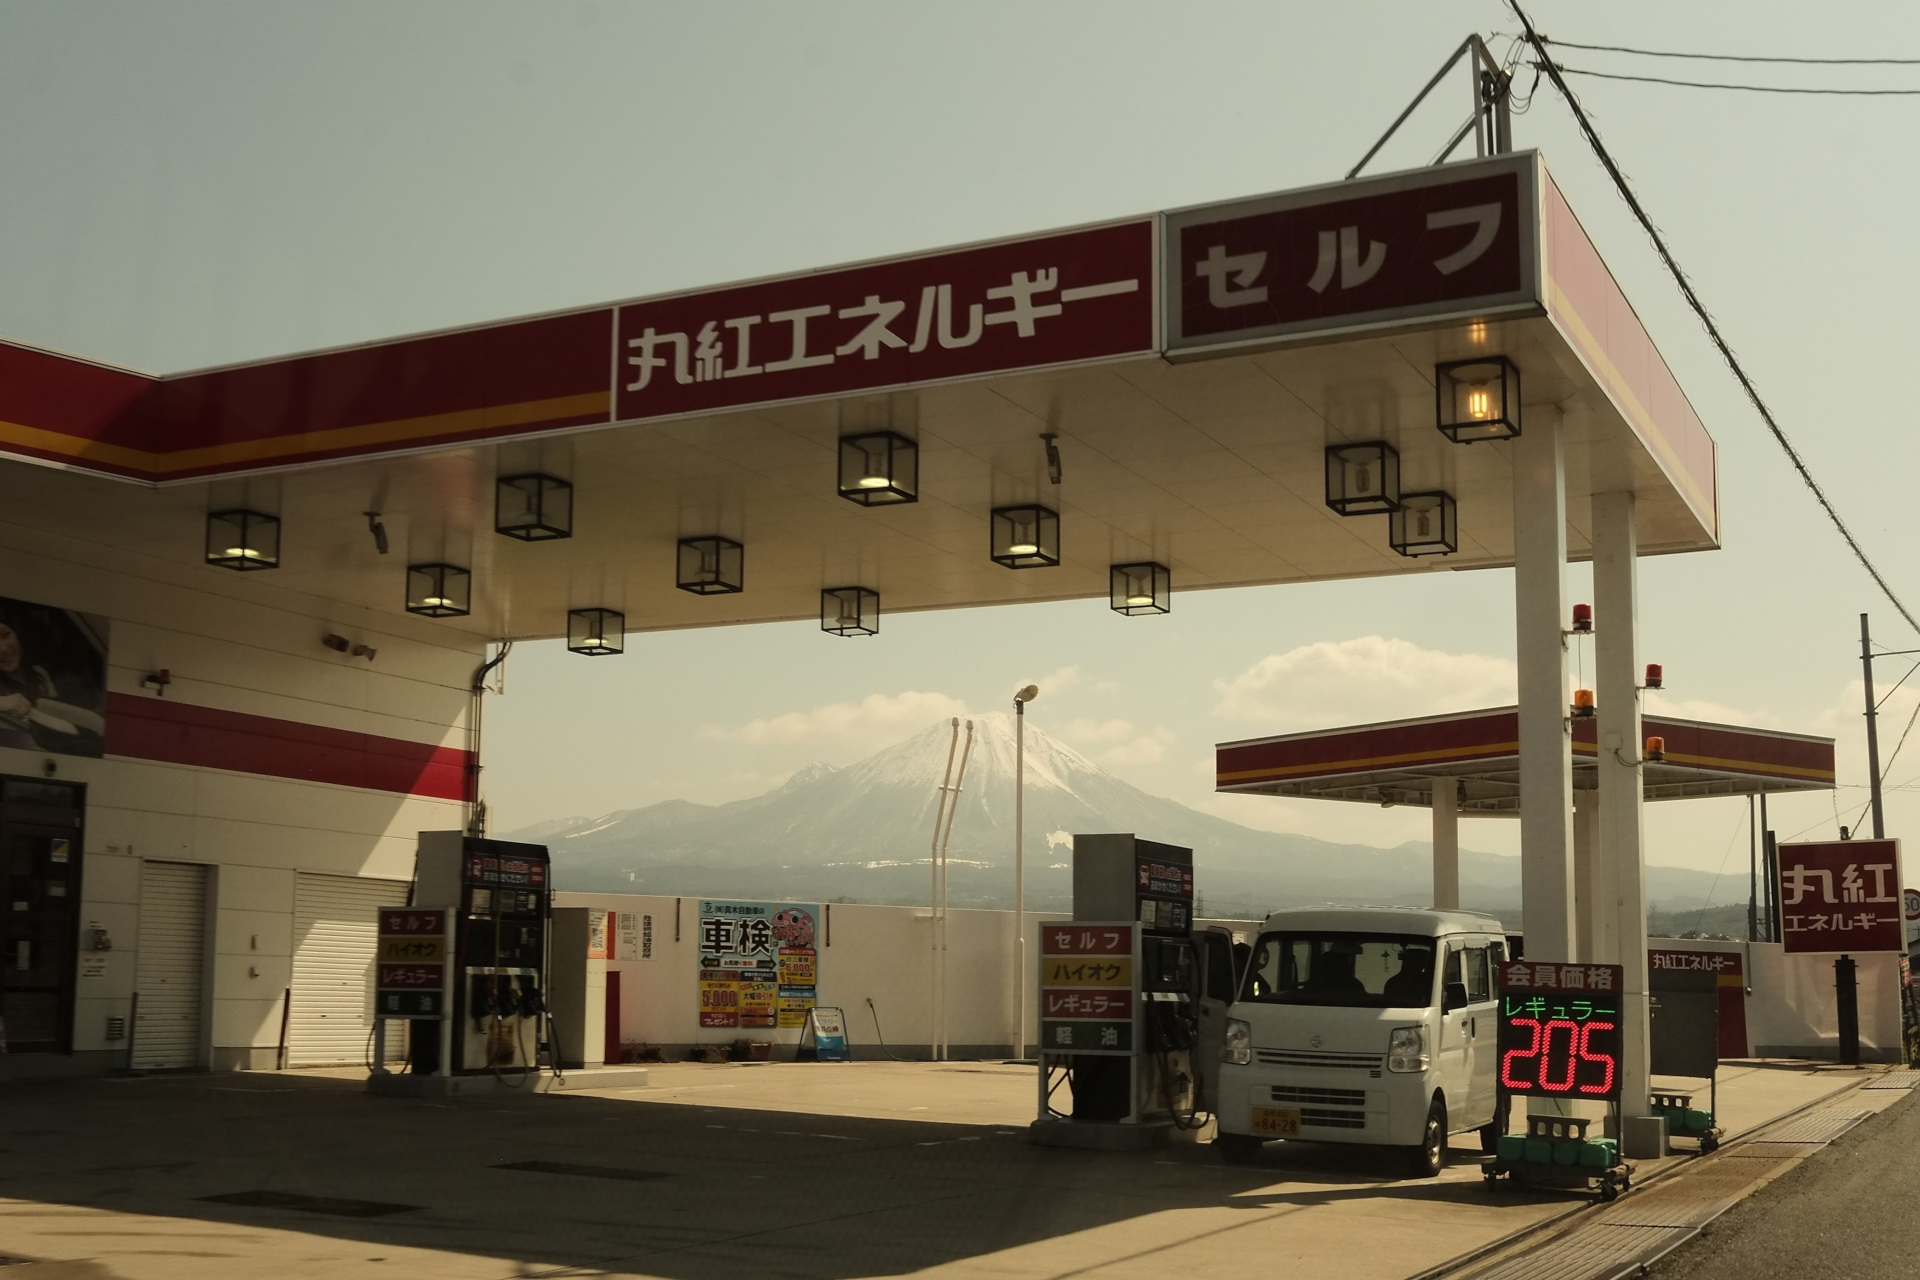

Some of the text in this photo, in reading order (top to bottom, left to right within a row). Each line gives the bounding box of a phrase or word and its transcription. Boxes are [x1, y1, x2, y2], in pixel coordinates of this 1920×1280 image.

[1196, 202, 1502, 309] セルフ
[626, 267, 1139, 392] 丸紅エネルギー
[1782, 863, 1897, 905] 丸紅
[389, 916, 436, 930] セルフ
[1784, 913, 1899, 931] エネルギー
[700, 916, 773, 956] 車検
[1054, 931, 1119, 950] セルフ
[387, 943, 436, 957] ハイオク
[1653, 953, 1735, 971] 丸紅エネルギー
[383, 968, 438, 983] レギュラー
[1053, 964, 1122, 981] ハイオク
[1507, 964, 1613, 990] 会員価格
[1048, 995, 1125, 1013] レギュラー
[1506, 996, 1615, 1019] レギュラー
[1056, 1026, 1118, 1046] 軽油
[1502, 1018, 1615, 1093] 205
[1261, 1118, 1297, 1132] 84-28
